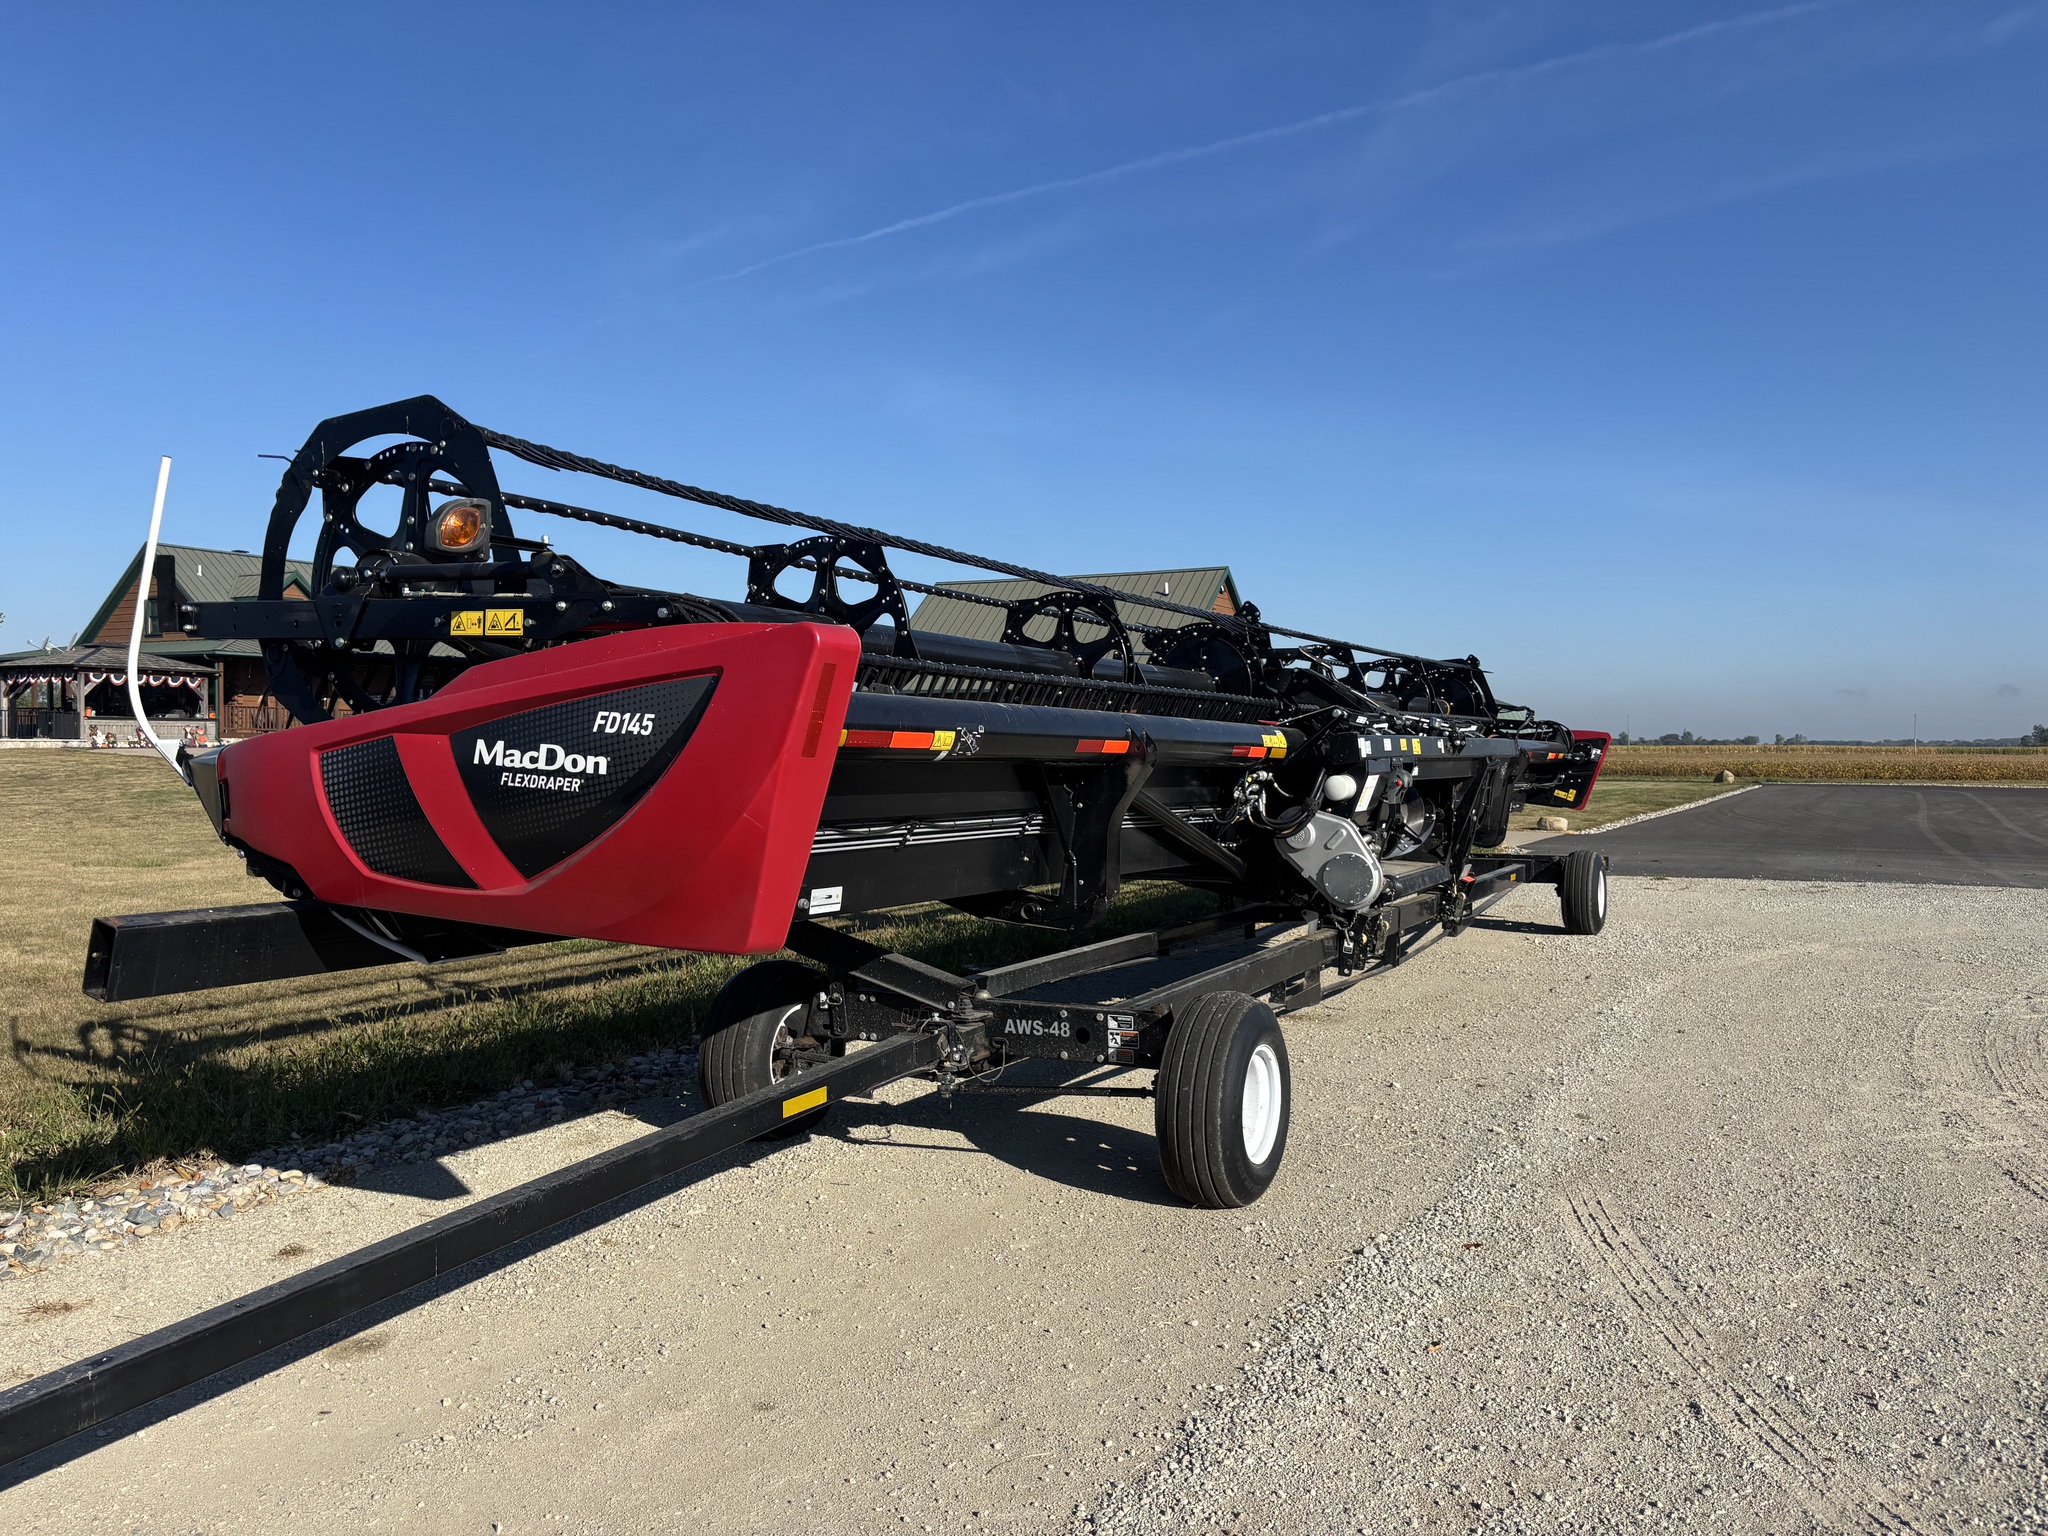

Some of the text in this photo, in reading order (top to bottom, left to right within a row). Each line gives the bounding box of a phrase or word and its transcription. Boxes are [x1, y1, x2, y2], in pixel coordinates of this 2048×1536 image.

[593, 711, 655, 735] FD145
[473, 739, 608, 775] MacDon
[501, 772, 582, 792] FLEXDRAPER
[1004, 1019, 1070, 1037] AWS-48
